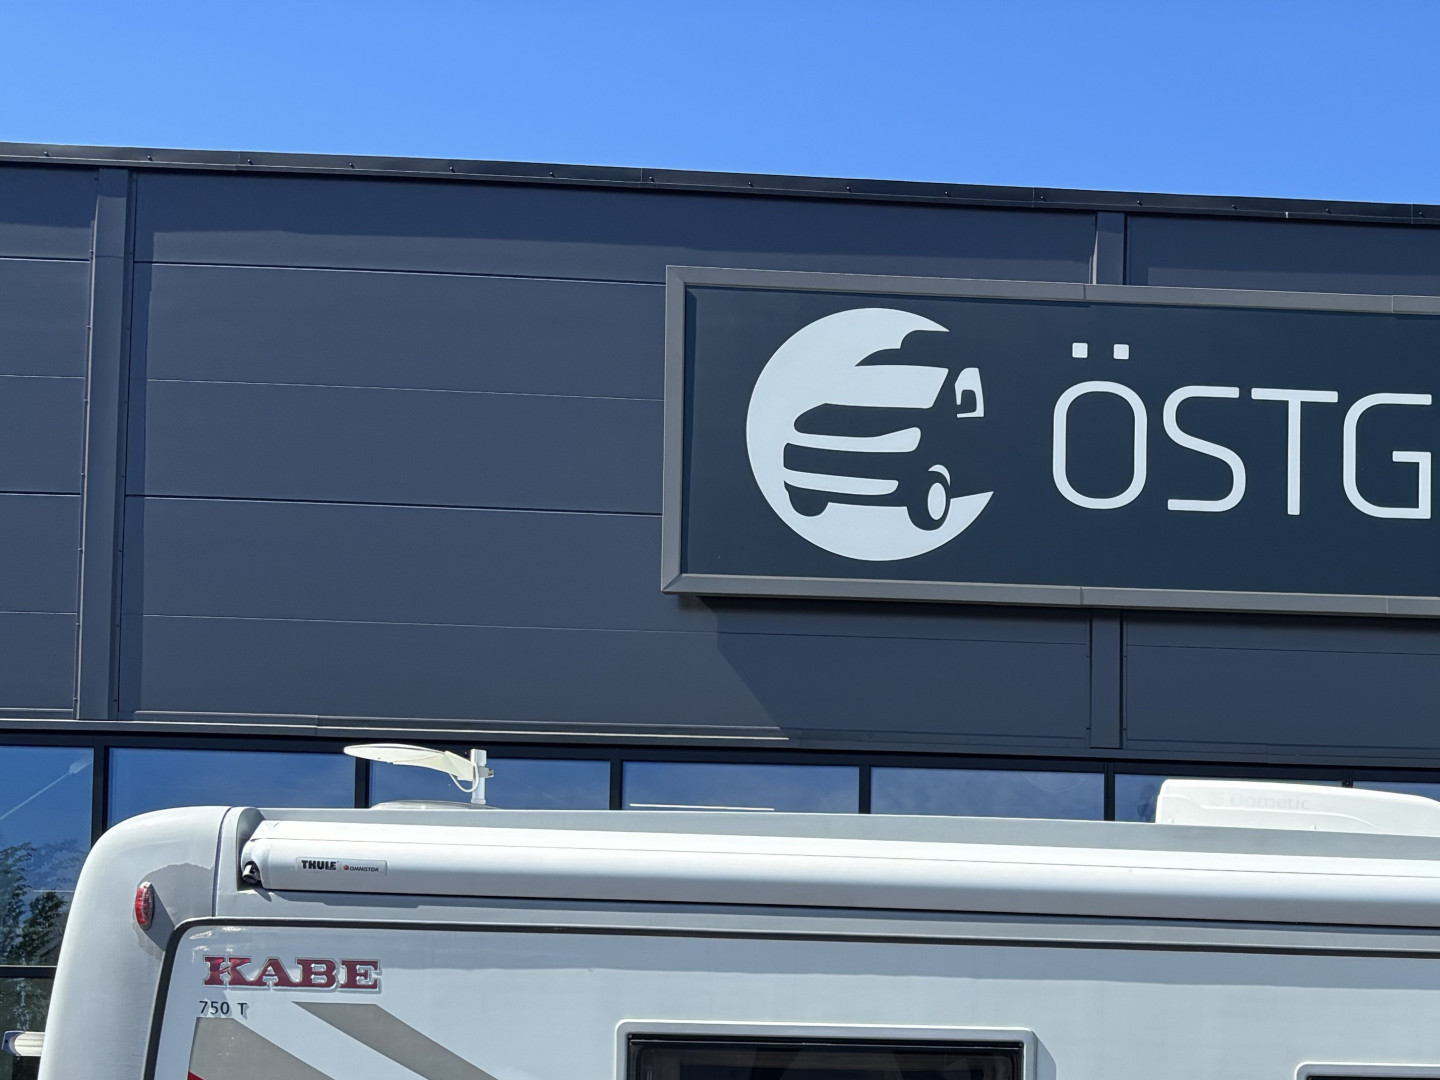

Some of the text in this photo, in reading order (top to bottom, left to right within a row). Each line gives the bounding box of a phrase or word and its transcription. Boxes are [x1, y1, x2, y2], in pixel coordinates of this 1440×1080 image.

[301, 859, 337, 871] THULE
[203, 956, 381, 992] KABE
[199, 1000, 247, 1016] 750 T
